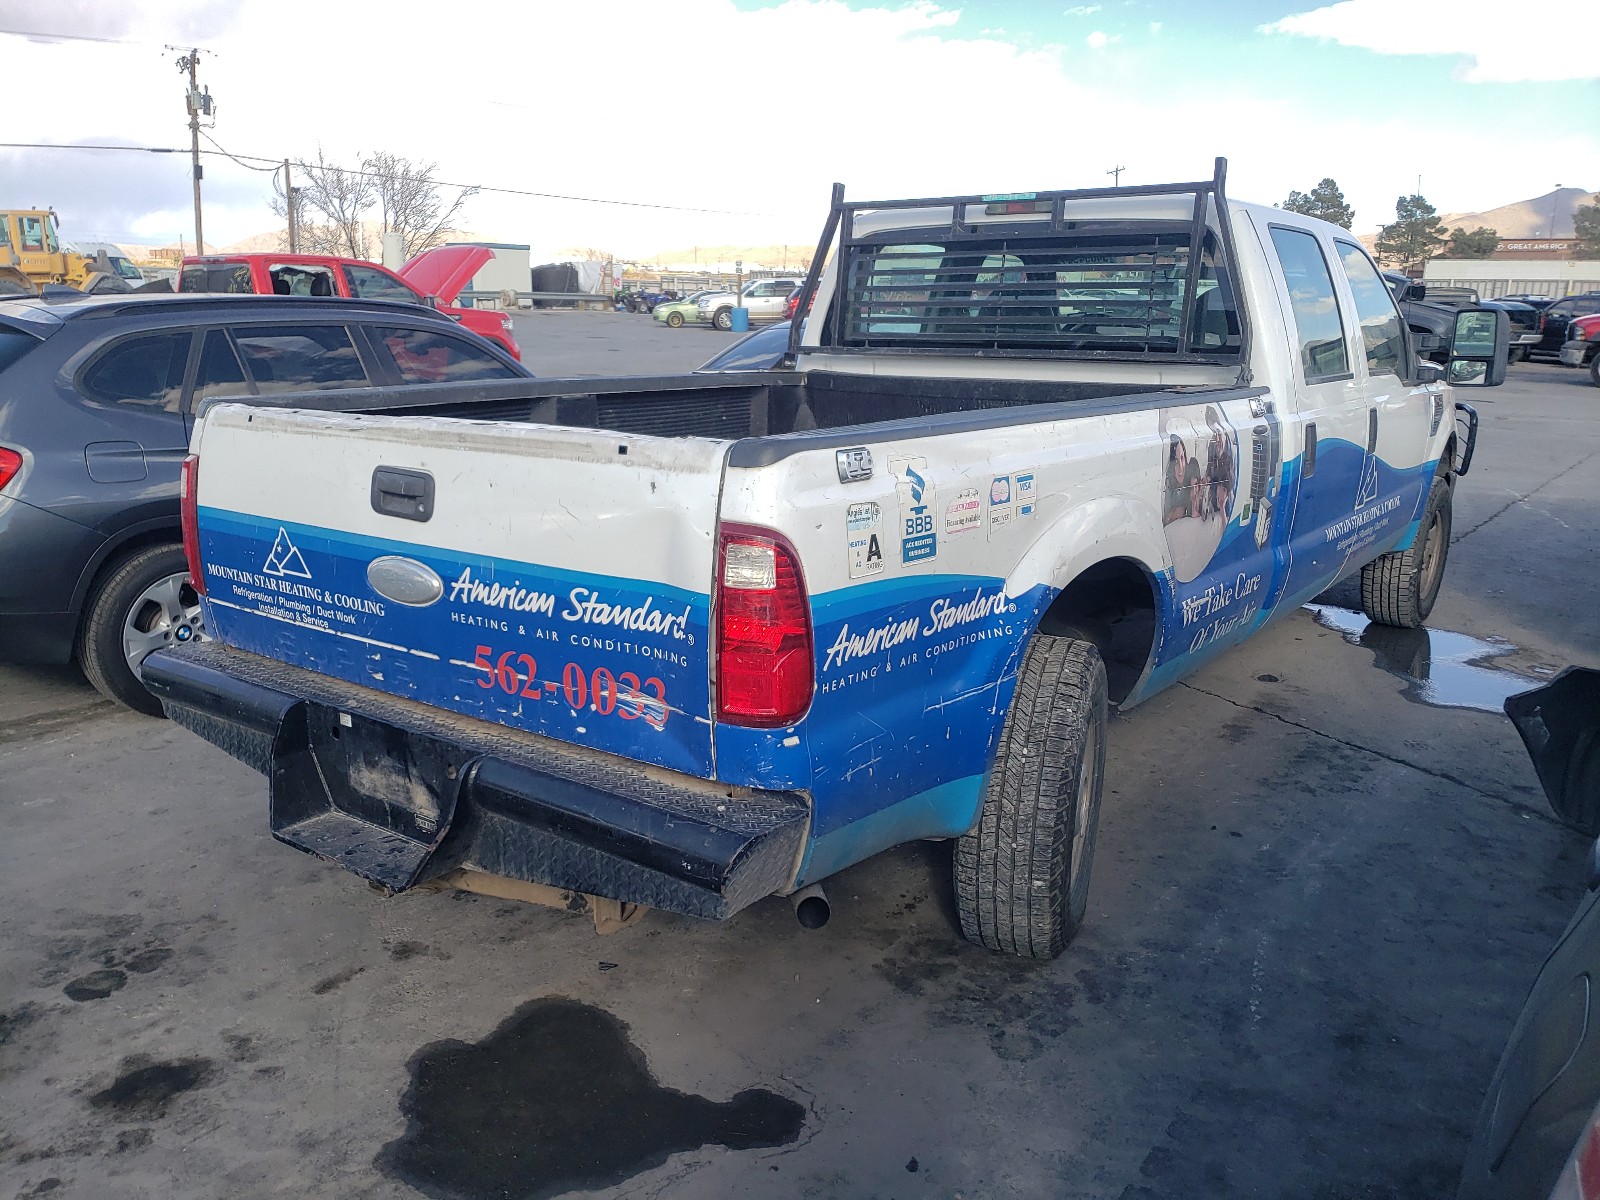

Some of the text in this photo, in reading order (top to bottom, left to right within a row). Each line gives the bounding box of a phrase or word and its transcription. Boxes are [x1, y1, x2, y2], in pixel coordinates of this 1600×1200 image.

[1020, 482, 1032, 491] VISA
[905, 515, 933, 536] BBB
[992, 514, 1010, 523] DISCVER
[867, 533, 882, 562] A
[207, 562, 385, 617] MOUNTAIN STAR HEATING & COOLING
[232, 584, 273, 605] Refrigeration
[279, 596, 311, 615] Plumbing
[317, 605, 335, 619] Duct
[335, 610, 356, 625] Work
[450, 566, 555, 618] American
[562, 587, 691, 639] Standard
[1182, 572, 1261, 628] We Take Care
[258, 602, 295, 621] Installation
[302, 612, 329, 629] Service
[451, 612, 688, 667] HEATING & AIR CONDITIONING
[822, 616, 920, 672] American
[923, 582, 1008, 637] Standard
[1189, 623, 1212, 654] Of
[822, 625, 1013, 694] HEATING & AIR CONDITIONING
[474, 644, 670, 726] 562-0033
